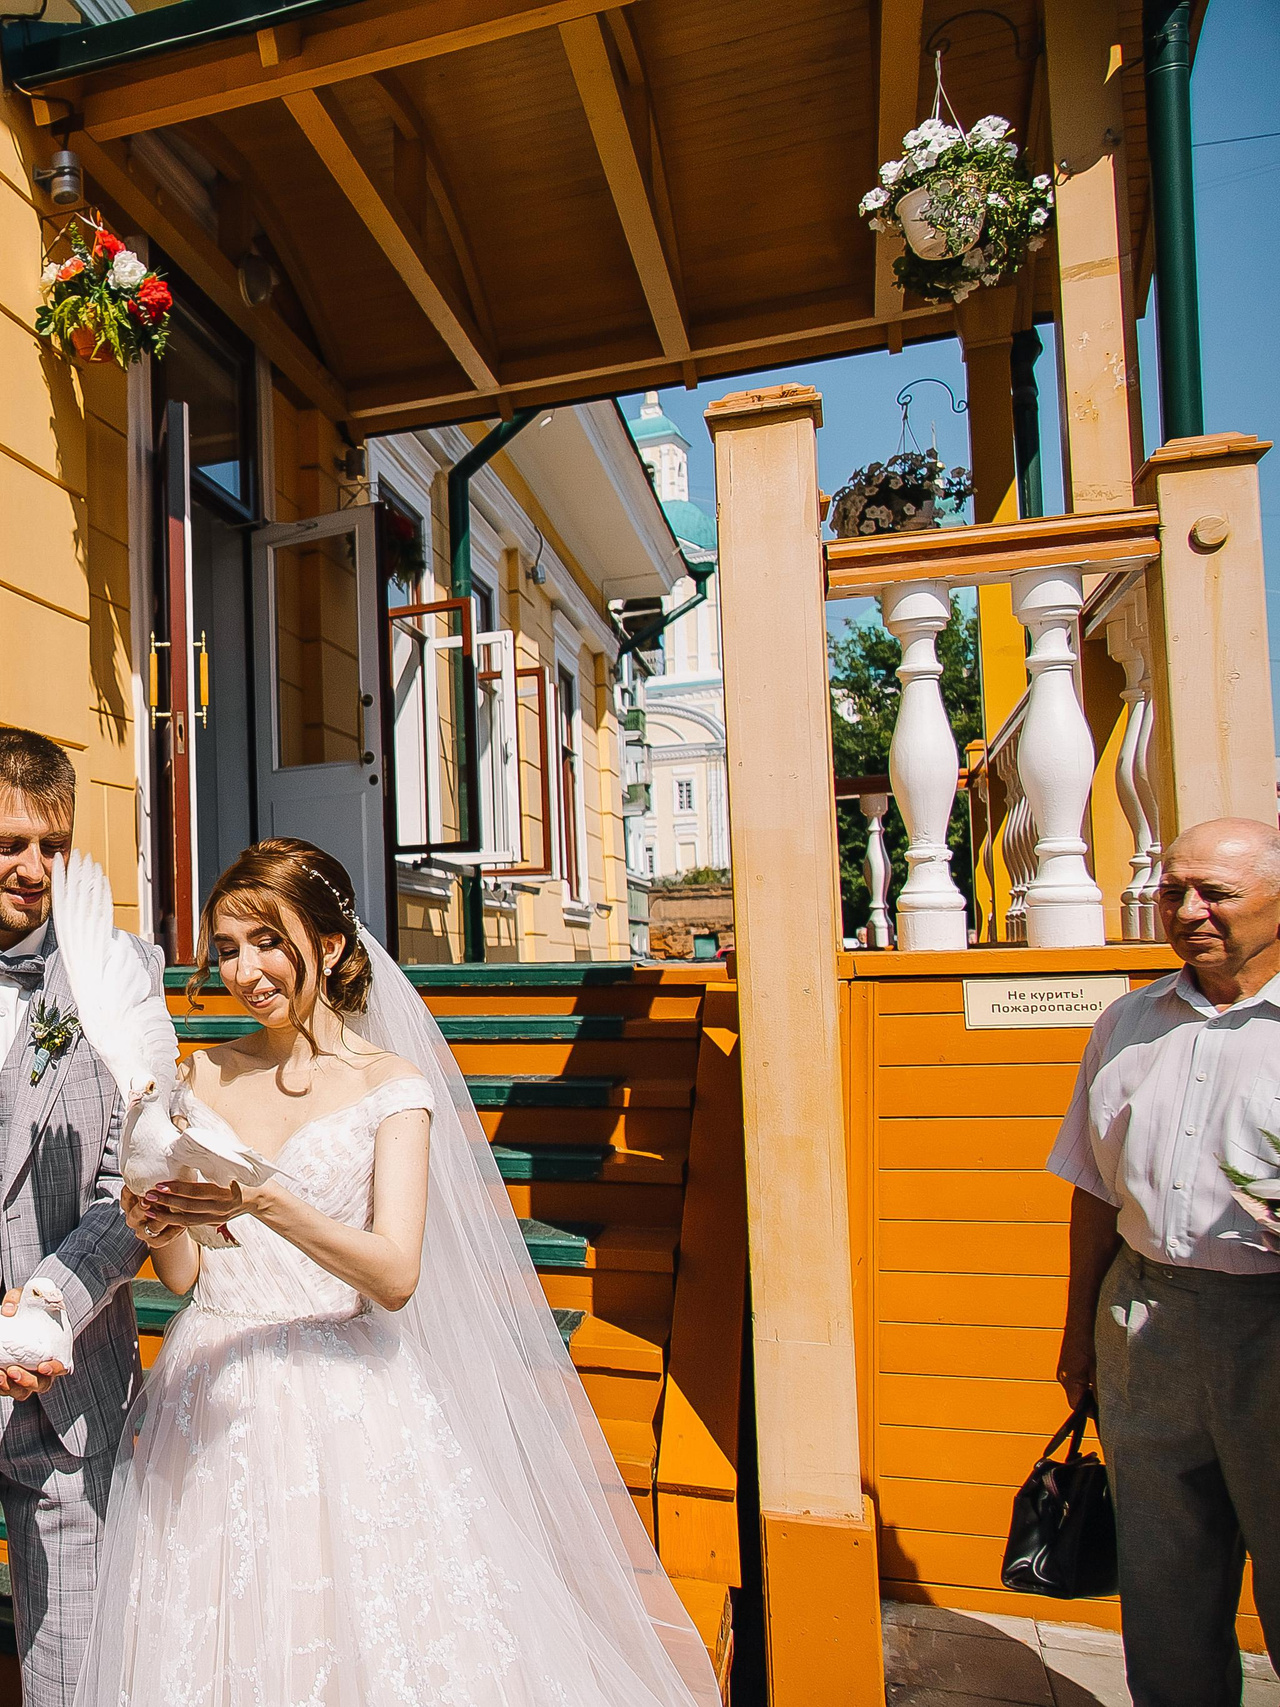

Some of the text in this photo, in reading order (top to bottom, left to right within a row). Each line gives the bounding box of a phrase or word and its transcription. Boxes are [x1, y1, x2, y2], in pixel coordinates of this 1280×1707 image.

[1008, 988, 1084, 1001] Не курить!
[991, 1001, 1103, 1014] Пожароопасно!
